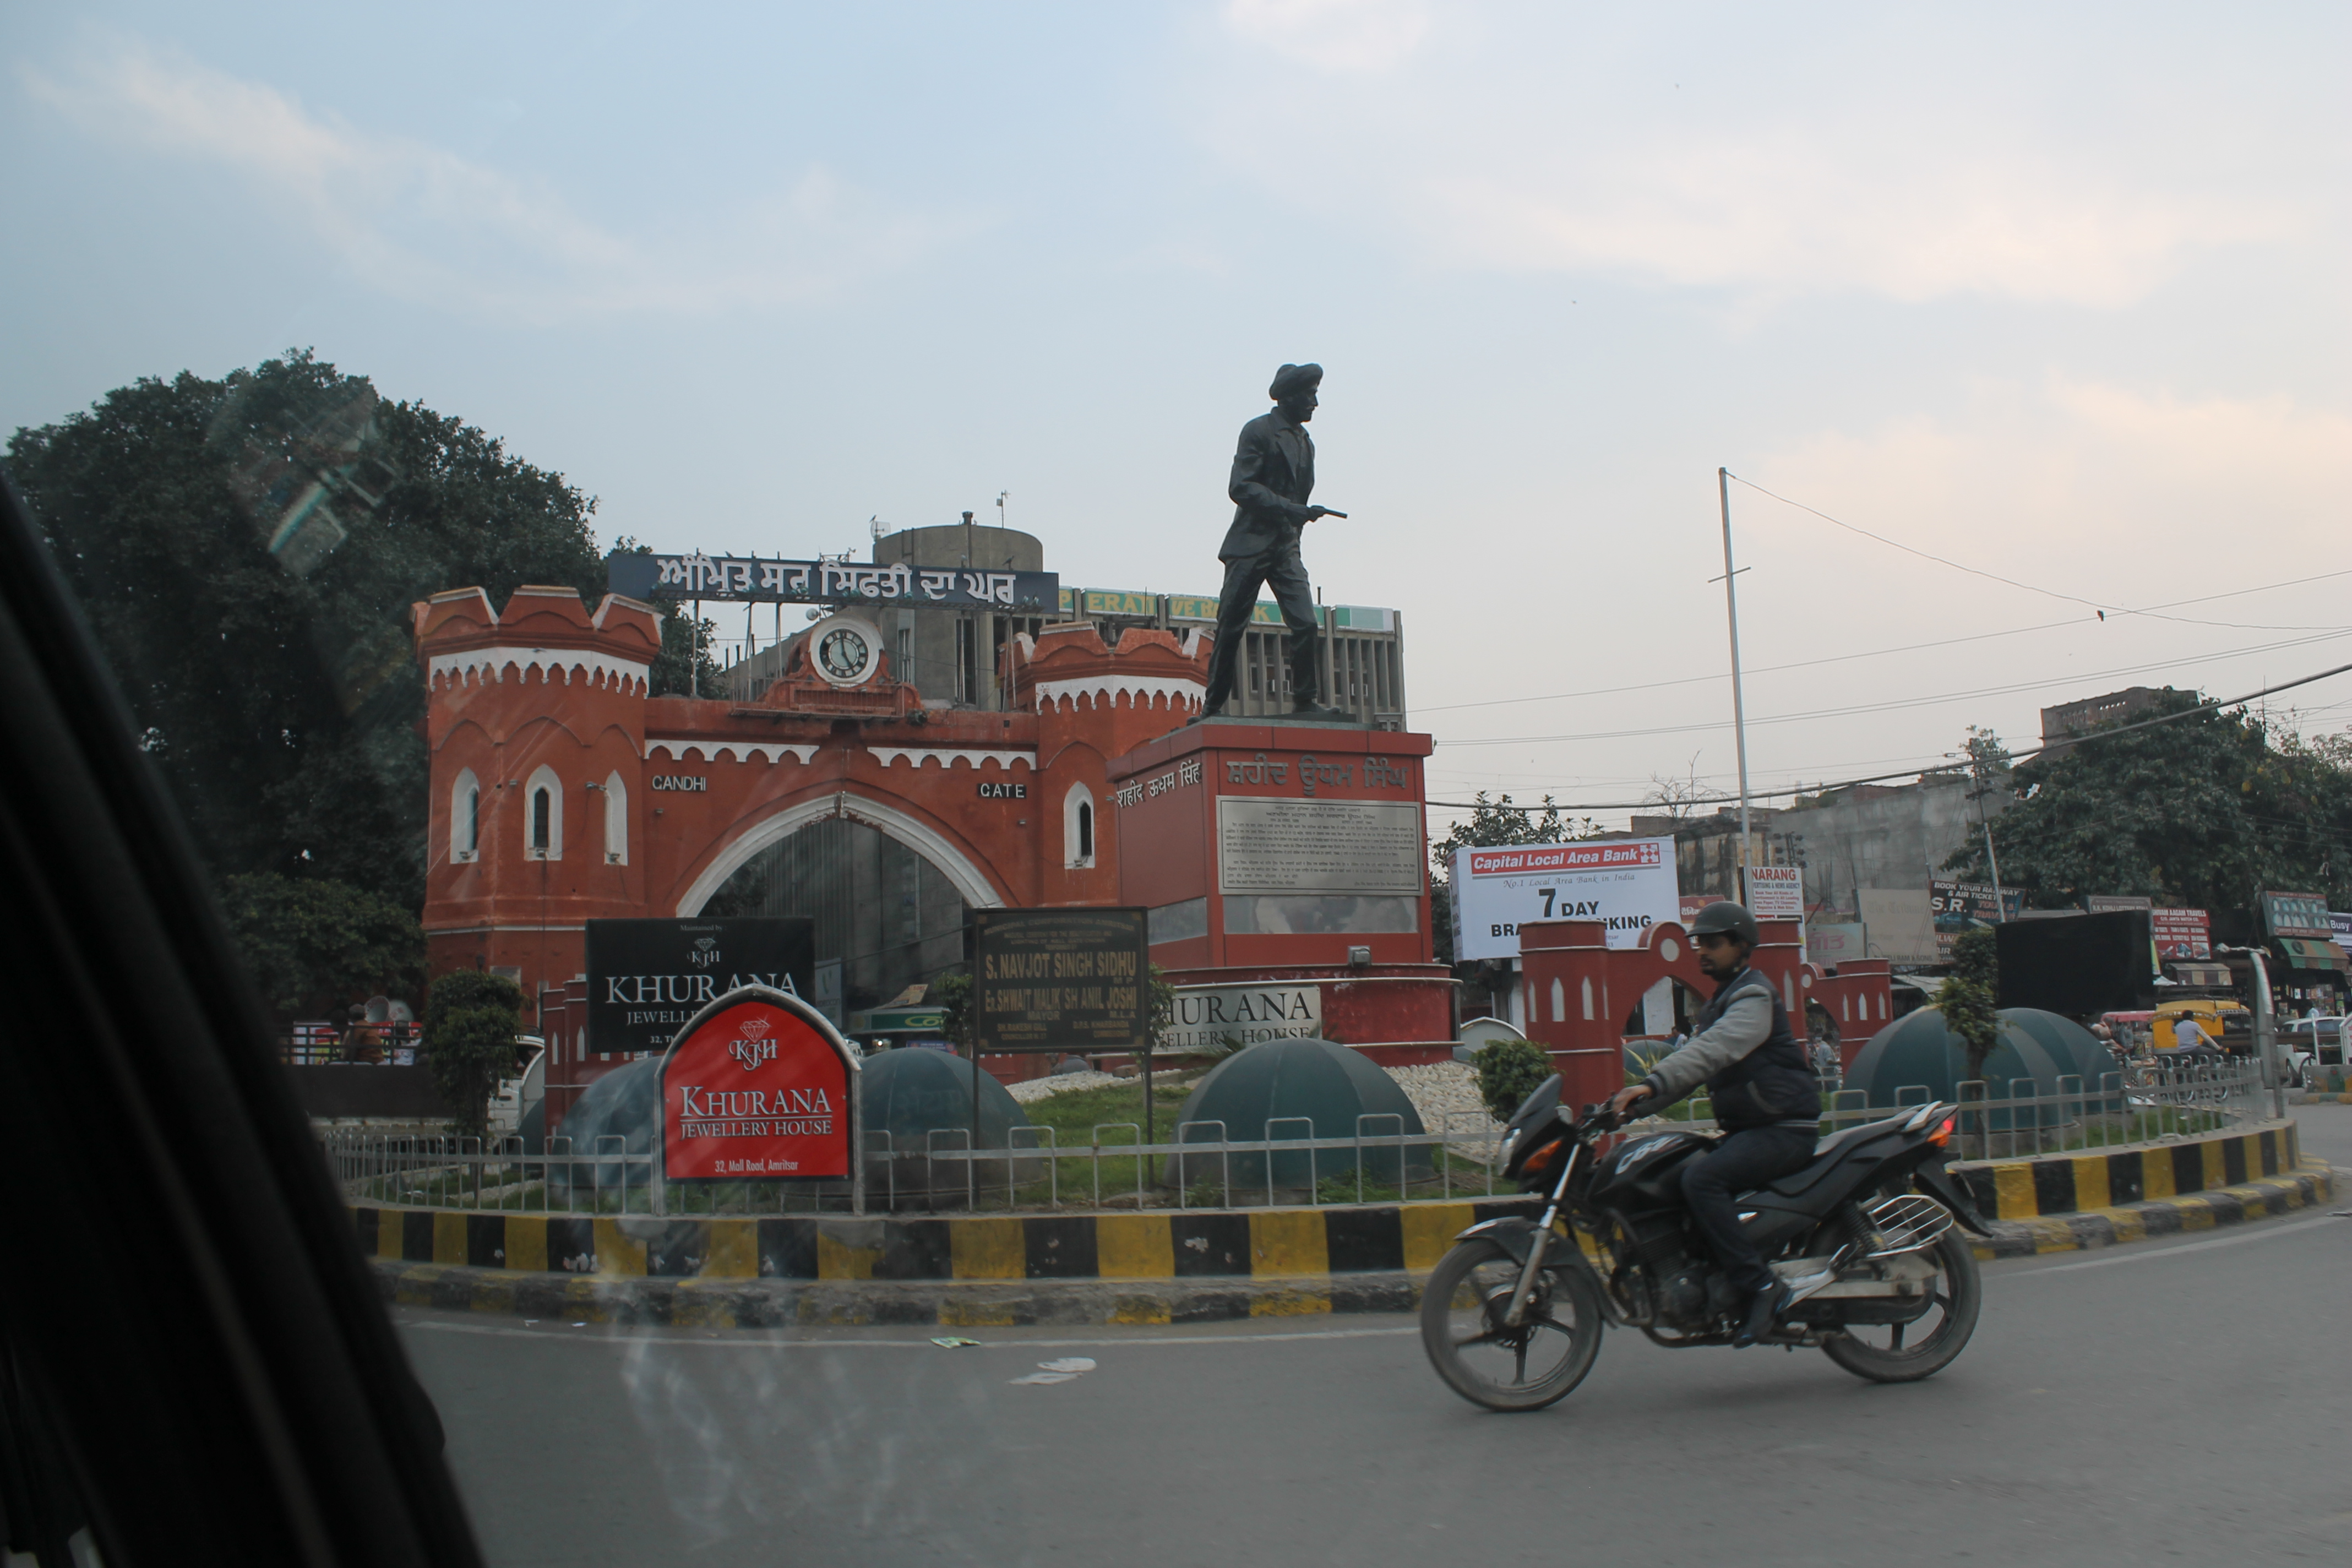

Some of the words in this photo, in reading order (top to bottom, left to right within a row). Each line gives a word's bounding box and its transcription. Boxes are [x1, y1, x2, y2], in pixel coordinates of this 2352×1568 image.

[920, 571, 956, 600] ਦਾ
[963, 573, 1016, 603] ਘਰ
[1117, 780, 1144, 807] शहीद
[1147, 772, 1175, 797] ऊधम
[1179, 759, 1201, 787] सिंह
[1227, 753, 1288, 785] ਸ਼ਹੀਦ
[1298, 755, 1353, 796] ਊਧਮ
[1363, 757, 1408, 788] ਸਿੰਘ
[652, 776, 706, 792] GANDHI
[980, 783, 1025, 798] GATE
[1474, 855, 1523, 872] Capital
[1527, 852, 1564, 867] Local
[1567, 851, 1599, 864] Area
[1603, 848, 1638, 862] Bank
[1504, 879, 1524, 889] No.1
[1529, 878, 1550, 886] Local
[1577, 875, 1599, 884] Bank
[1614, 873, 1635, 881] India
[1752, 868, 1796, 880] NARANG
[1934, 881, 1956, 890] BOOK
[1983, 886, 2019, 896] RAWAY
[1538, 888, 1556, 918] 7
[1561, 901, 1600, 917] DAY
[1931, 897, 1967, 912] S.R.
[2329, 919, 2350, 932] Busy
[1000, 953, 1050, 979] NAVJOT
[1054, 951, 1093, 978] SINGH
[1097, 951, 1136, 977] SIDHU
[1107, 986, 1137, 1010] JOSHI
[1166, 991, 1314, 1025] HURANA
[1027, 1010, 1060, 1020] MAYOR
[728, 1039, 778, 1071] KJH
[680, 1086, 832, 1117] KHURANA
[680, 1121, 769, 1140] JEWELLERY
[775, 1120, 832, 1135] HOUSE
[715, 1161, 727, 1174] 32,
[729, 1160, 744, 1172] Mall
[746, 1159, 766, 1174] Road,
[768, 1159, 798, 1172] Amritsar
